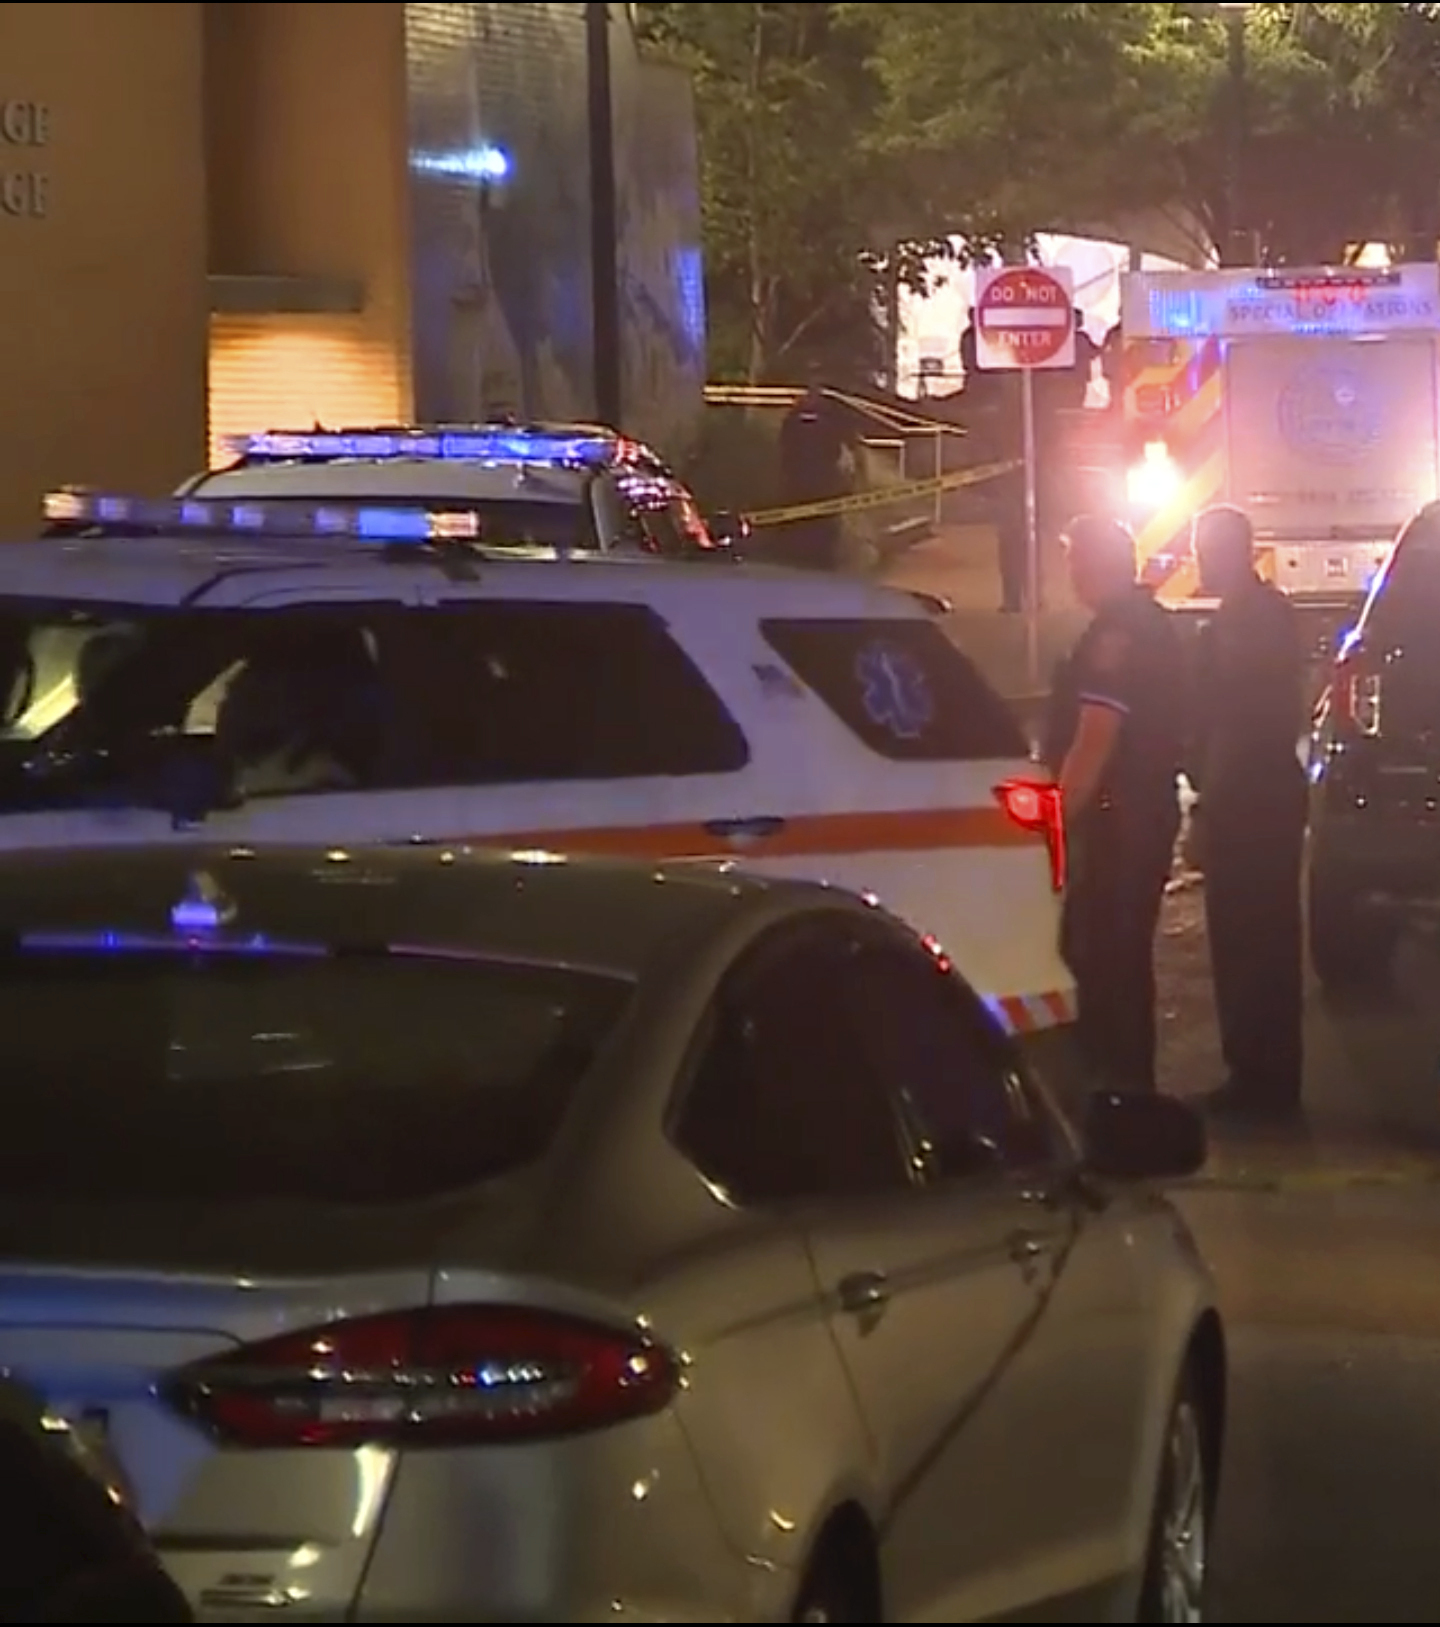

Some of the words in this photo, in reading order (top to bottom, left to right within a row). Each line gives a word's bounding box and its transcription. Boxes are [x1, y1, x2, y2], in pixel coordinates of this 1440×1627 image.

[991, 286, 1014, 302] DO
[1024, 285, 1057, 303] NOT
[1229, 303, 1304, 322] SPECIAL
[1313, 300, 1433, 320] OPATIONS
[997, 331, 1052, 347] ENTER
